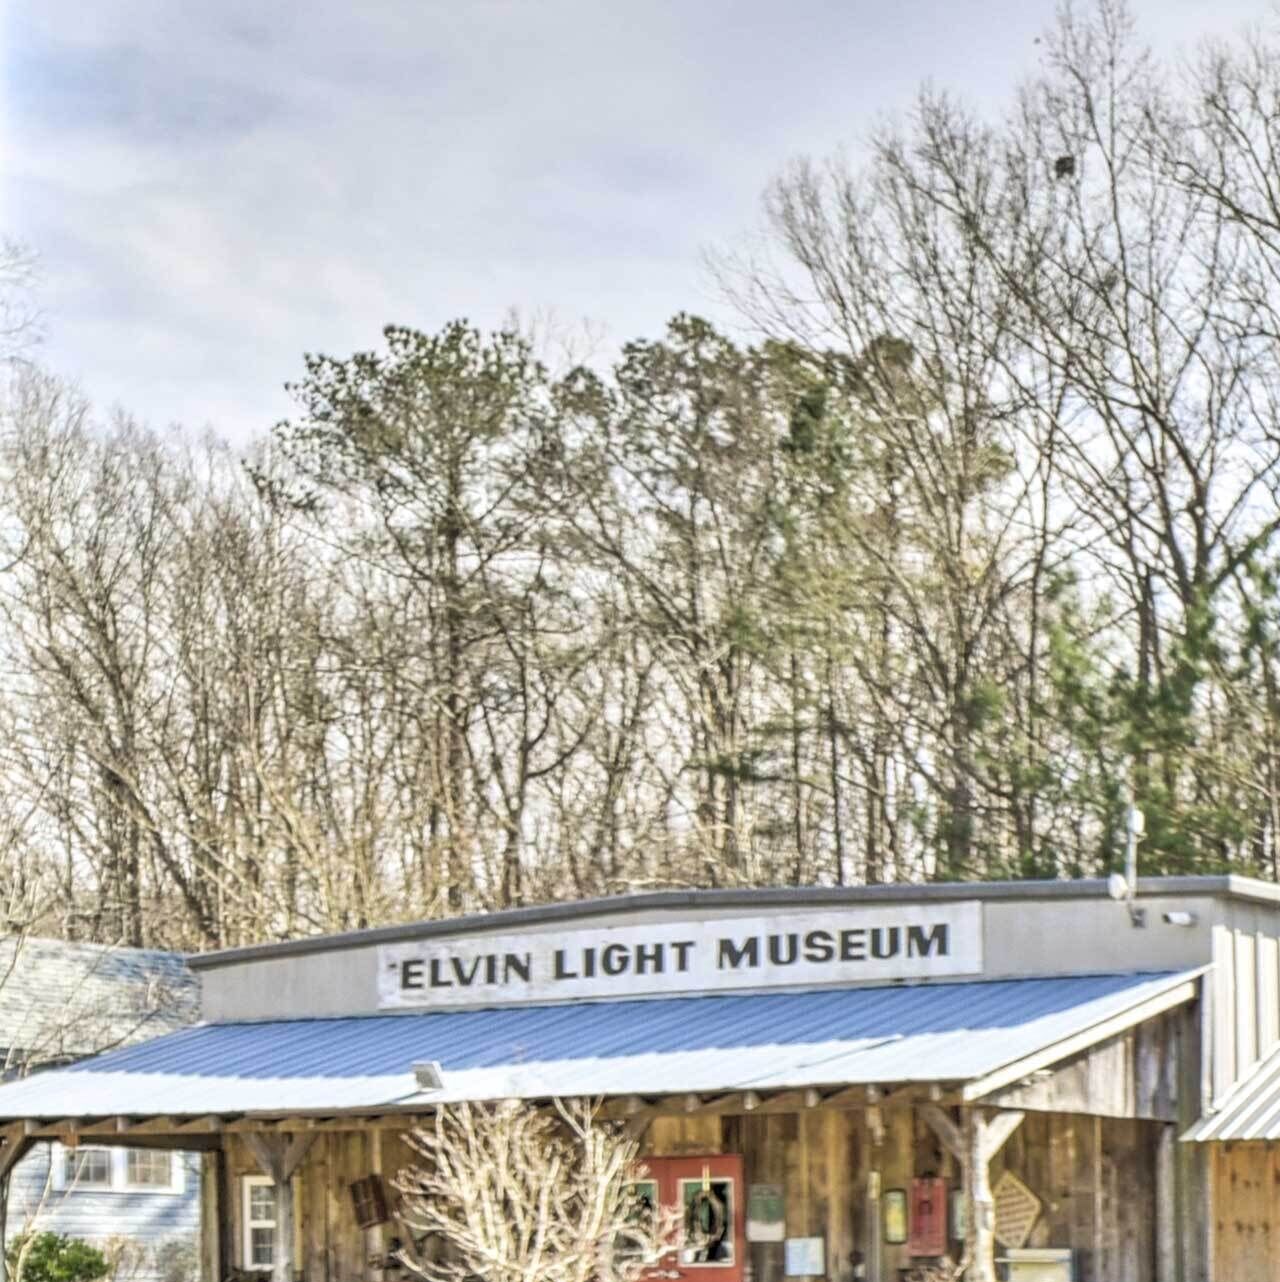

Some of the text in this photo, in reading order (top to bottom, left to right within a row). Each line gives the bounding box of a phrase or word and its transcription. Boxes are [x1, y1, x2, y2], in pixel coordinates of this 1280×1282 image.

[400, 924, 949, 989] ELVIN LIGHT MUSEUM
